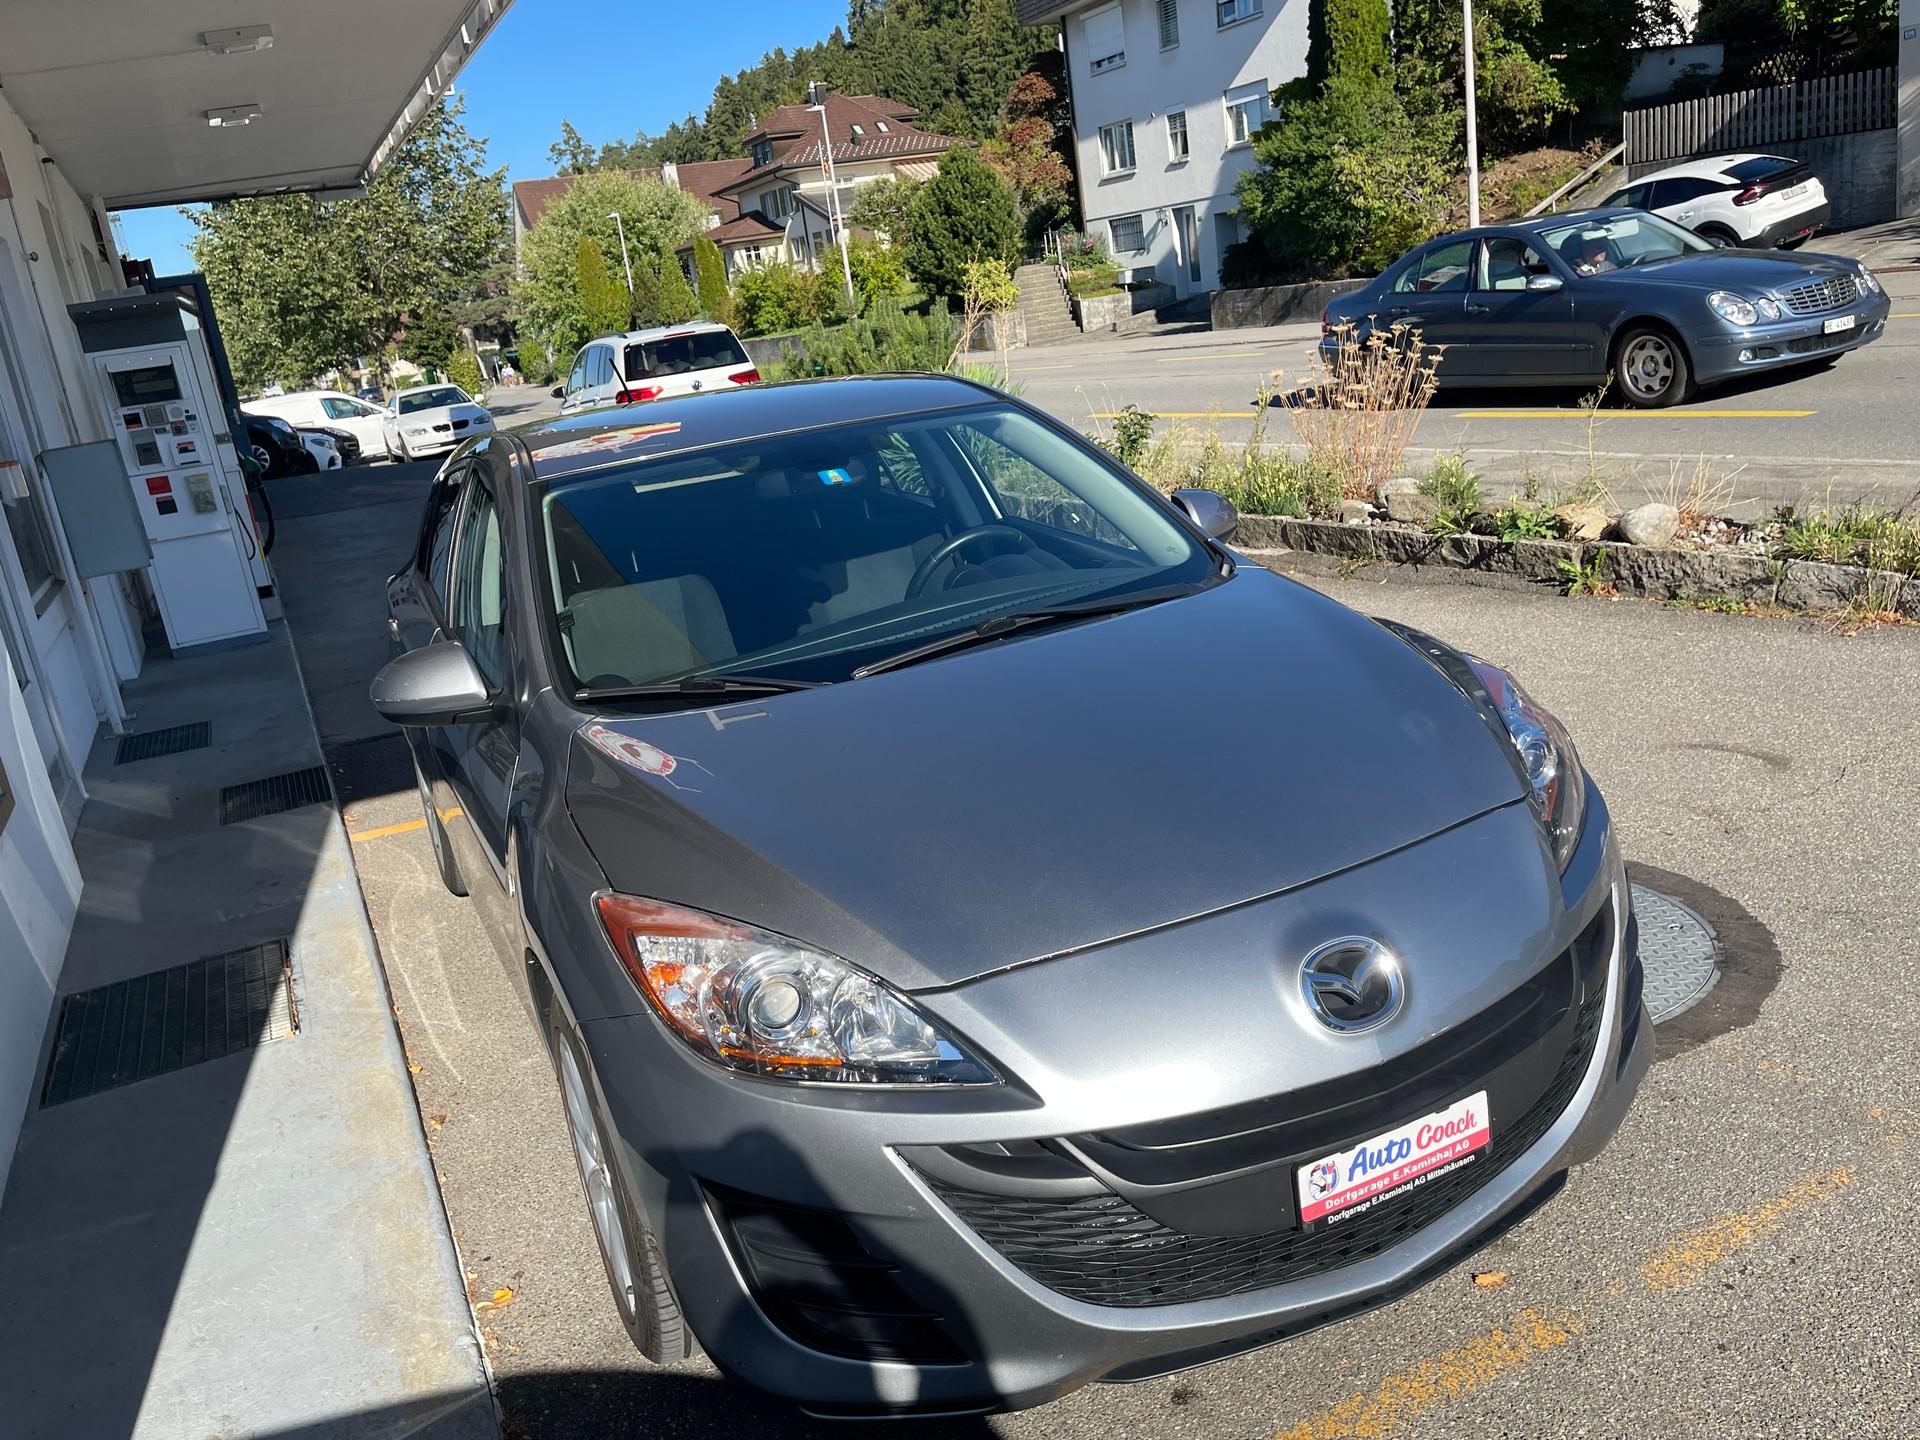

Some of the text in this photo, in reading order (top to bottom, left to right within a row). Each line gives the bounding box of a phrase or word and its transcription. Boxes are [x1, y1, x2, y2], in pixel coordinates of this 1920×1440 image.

[1325, 1139, 1470, 1210] Dorfgarage E.Kamishaj AG
[1348, 1109, 1477, 1181] Auto Coach
[1328, 1154, 1475, 1225] Dorfgarage E.Kamishaj AG Mittelhäusern
